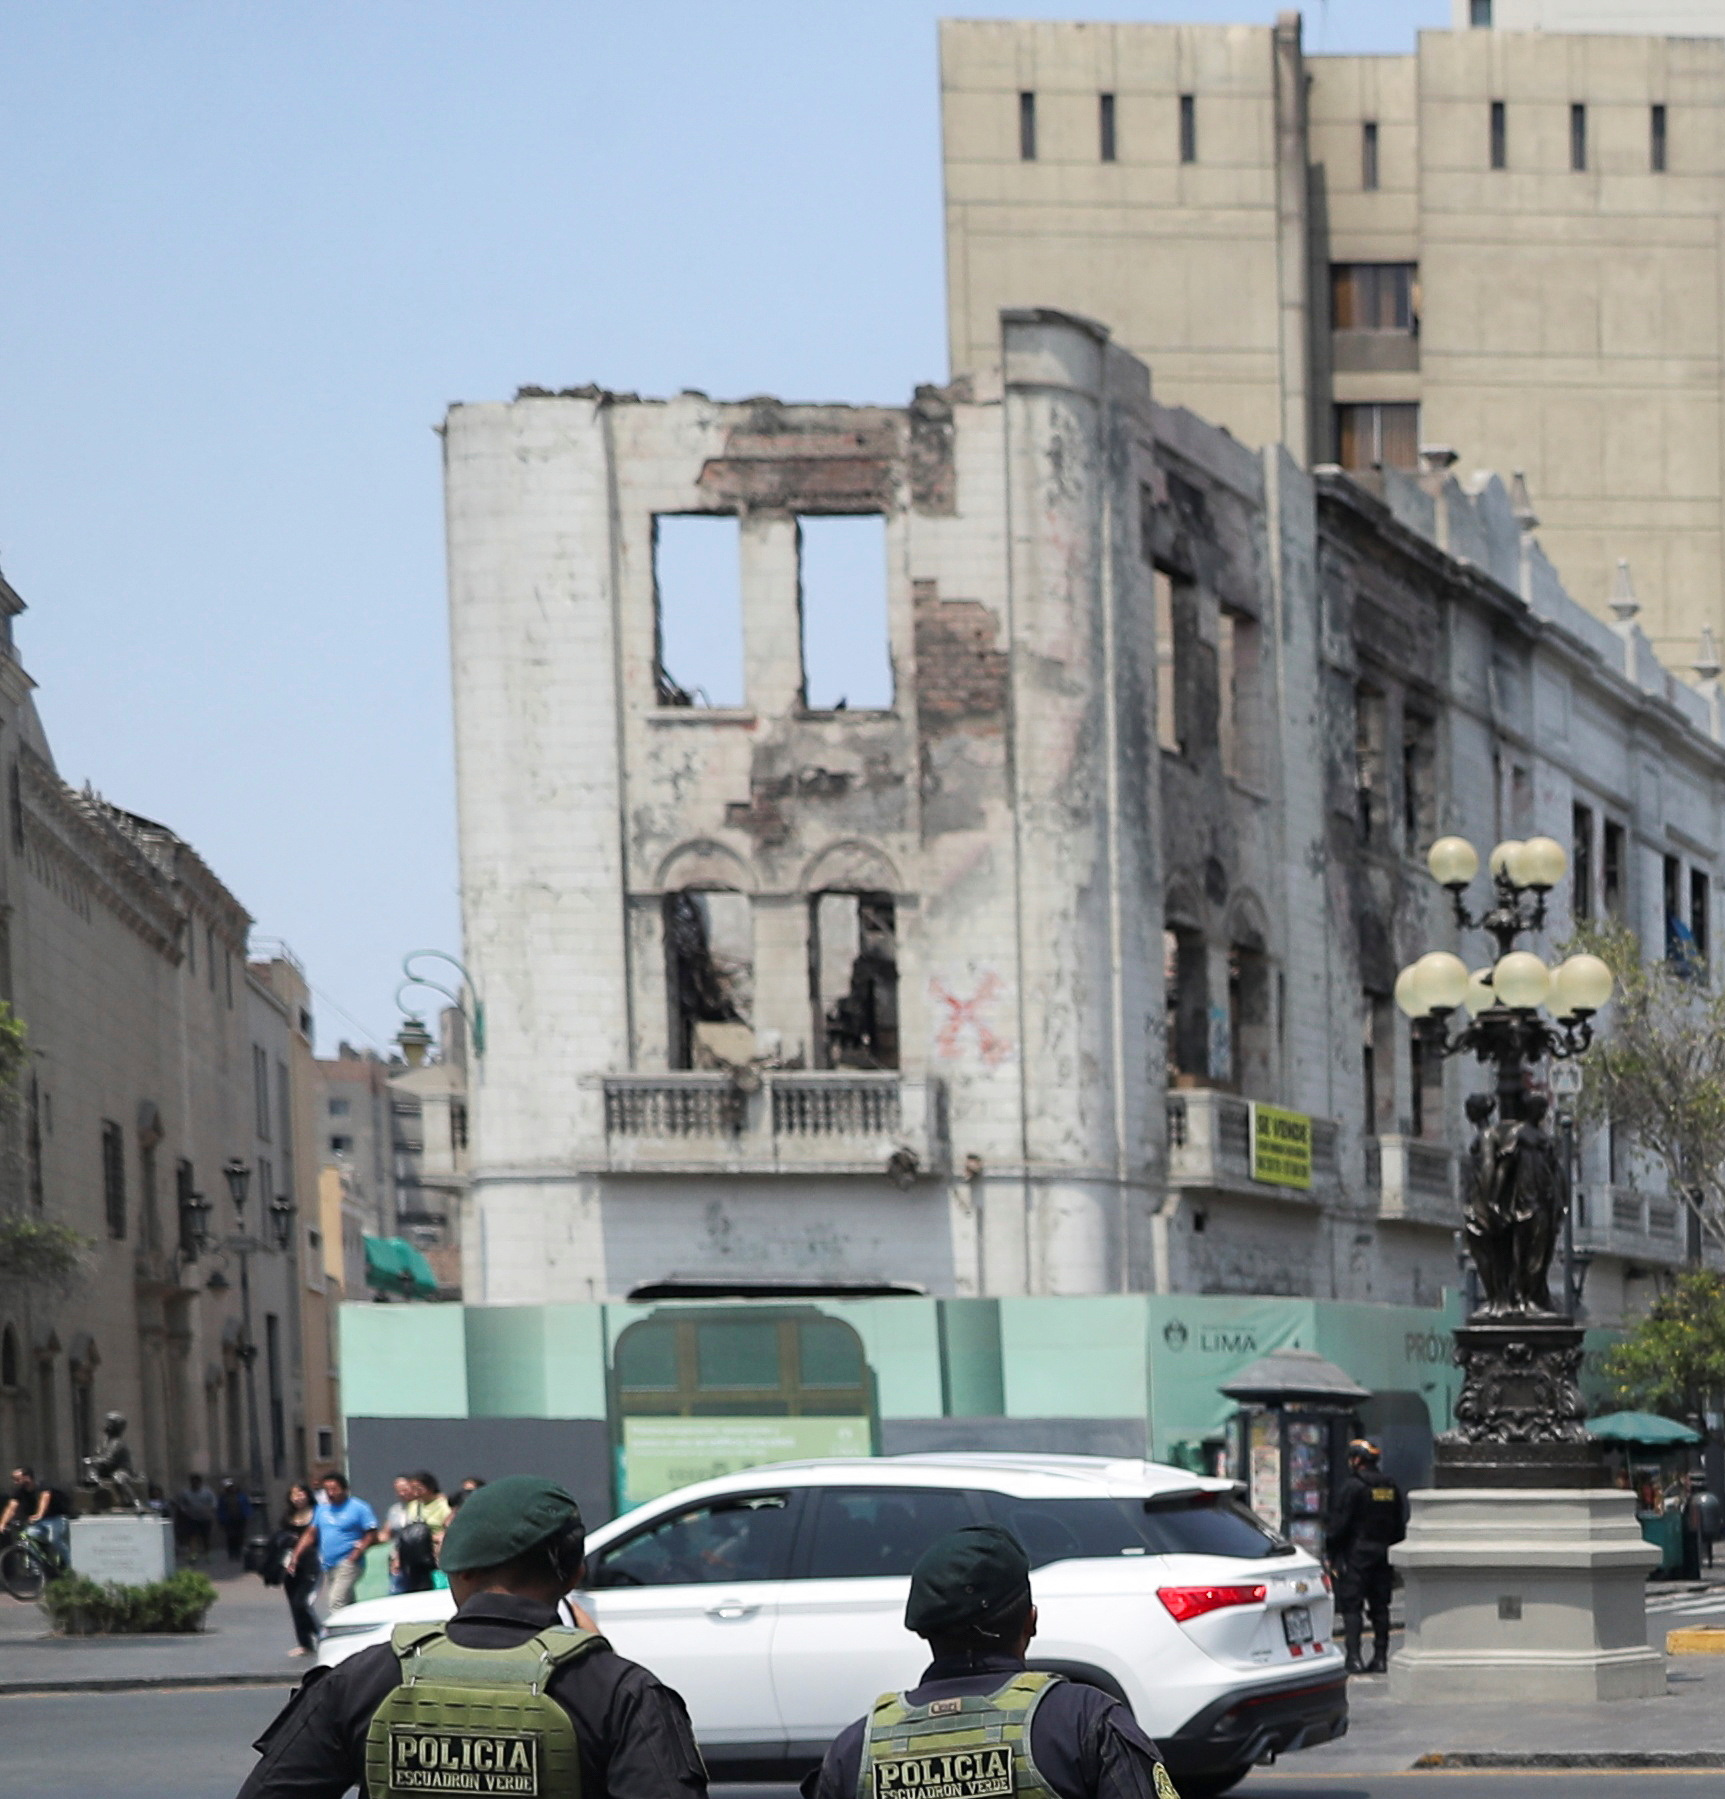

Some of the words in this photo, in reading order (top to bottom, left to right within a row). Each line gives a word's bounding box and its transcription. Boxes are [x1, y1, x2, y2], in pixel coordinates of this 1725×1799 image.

[1201, 1333, 1258, 1353] LIMA
[395, 1735, 532, 1773] POLICIA
[395, 1769, 481, 1791] ESCUADRON
[484, 1774, 533, 1792] VERDE
[878, 1751, 1007, 1790] POLICIA
[966, 1776, 1009, 1795] VERDE
